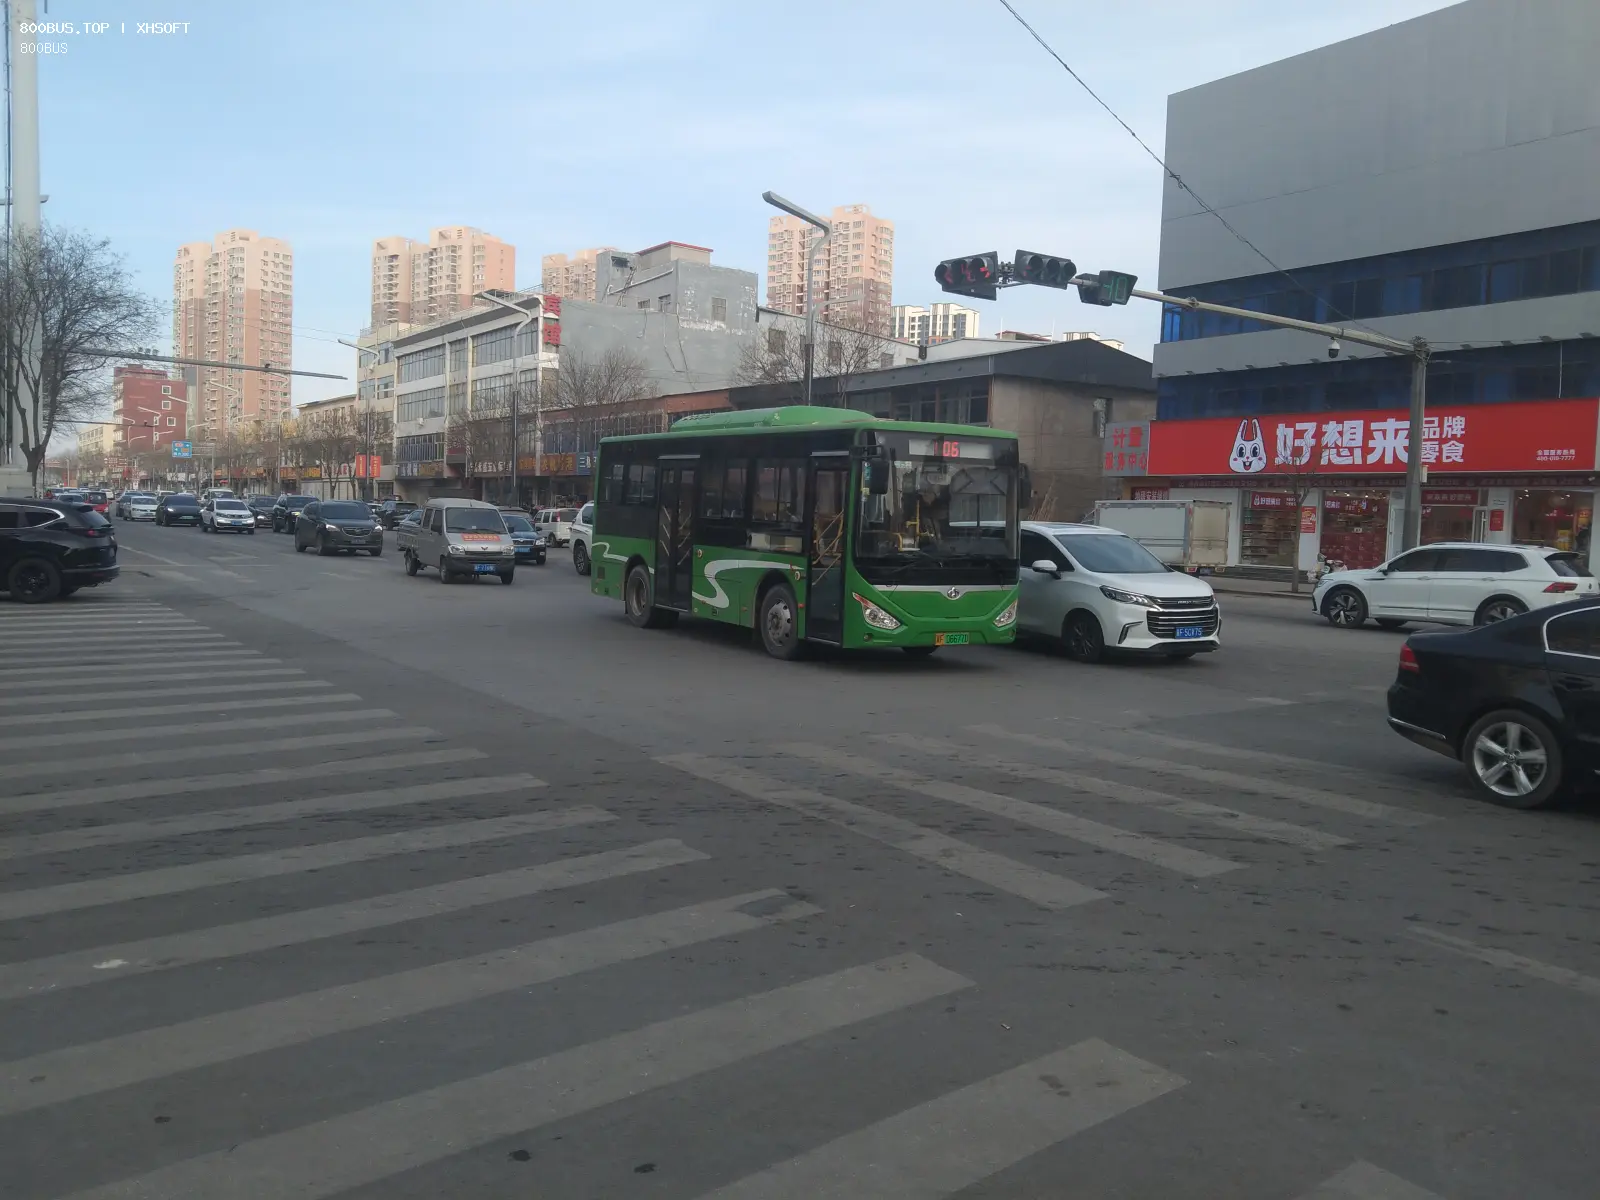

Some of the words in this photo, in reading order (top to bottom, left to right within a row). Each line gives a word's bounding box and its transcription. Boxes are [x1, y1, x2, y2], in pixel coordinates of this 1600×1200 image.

[543, 294, 562, 345] 宾馆
[1421, 416, 1466, 439] 品牌
[1274, 418, 1411, 466] 好想来
[1421, 440, 1465, 463] 零食
[1104, 451, 1148, 472] 服务中心
